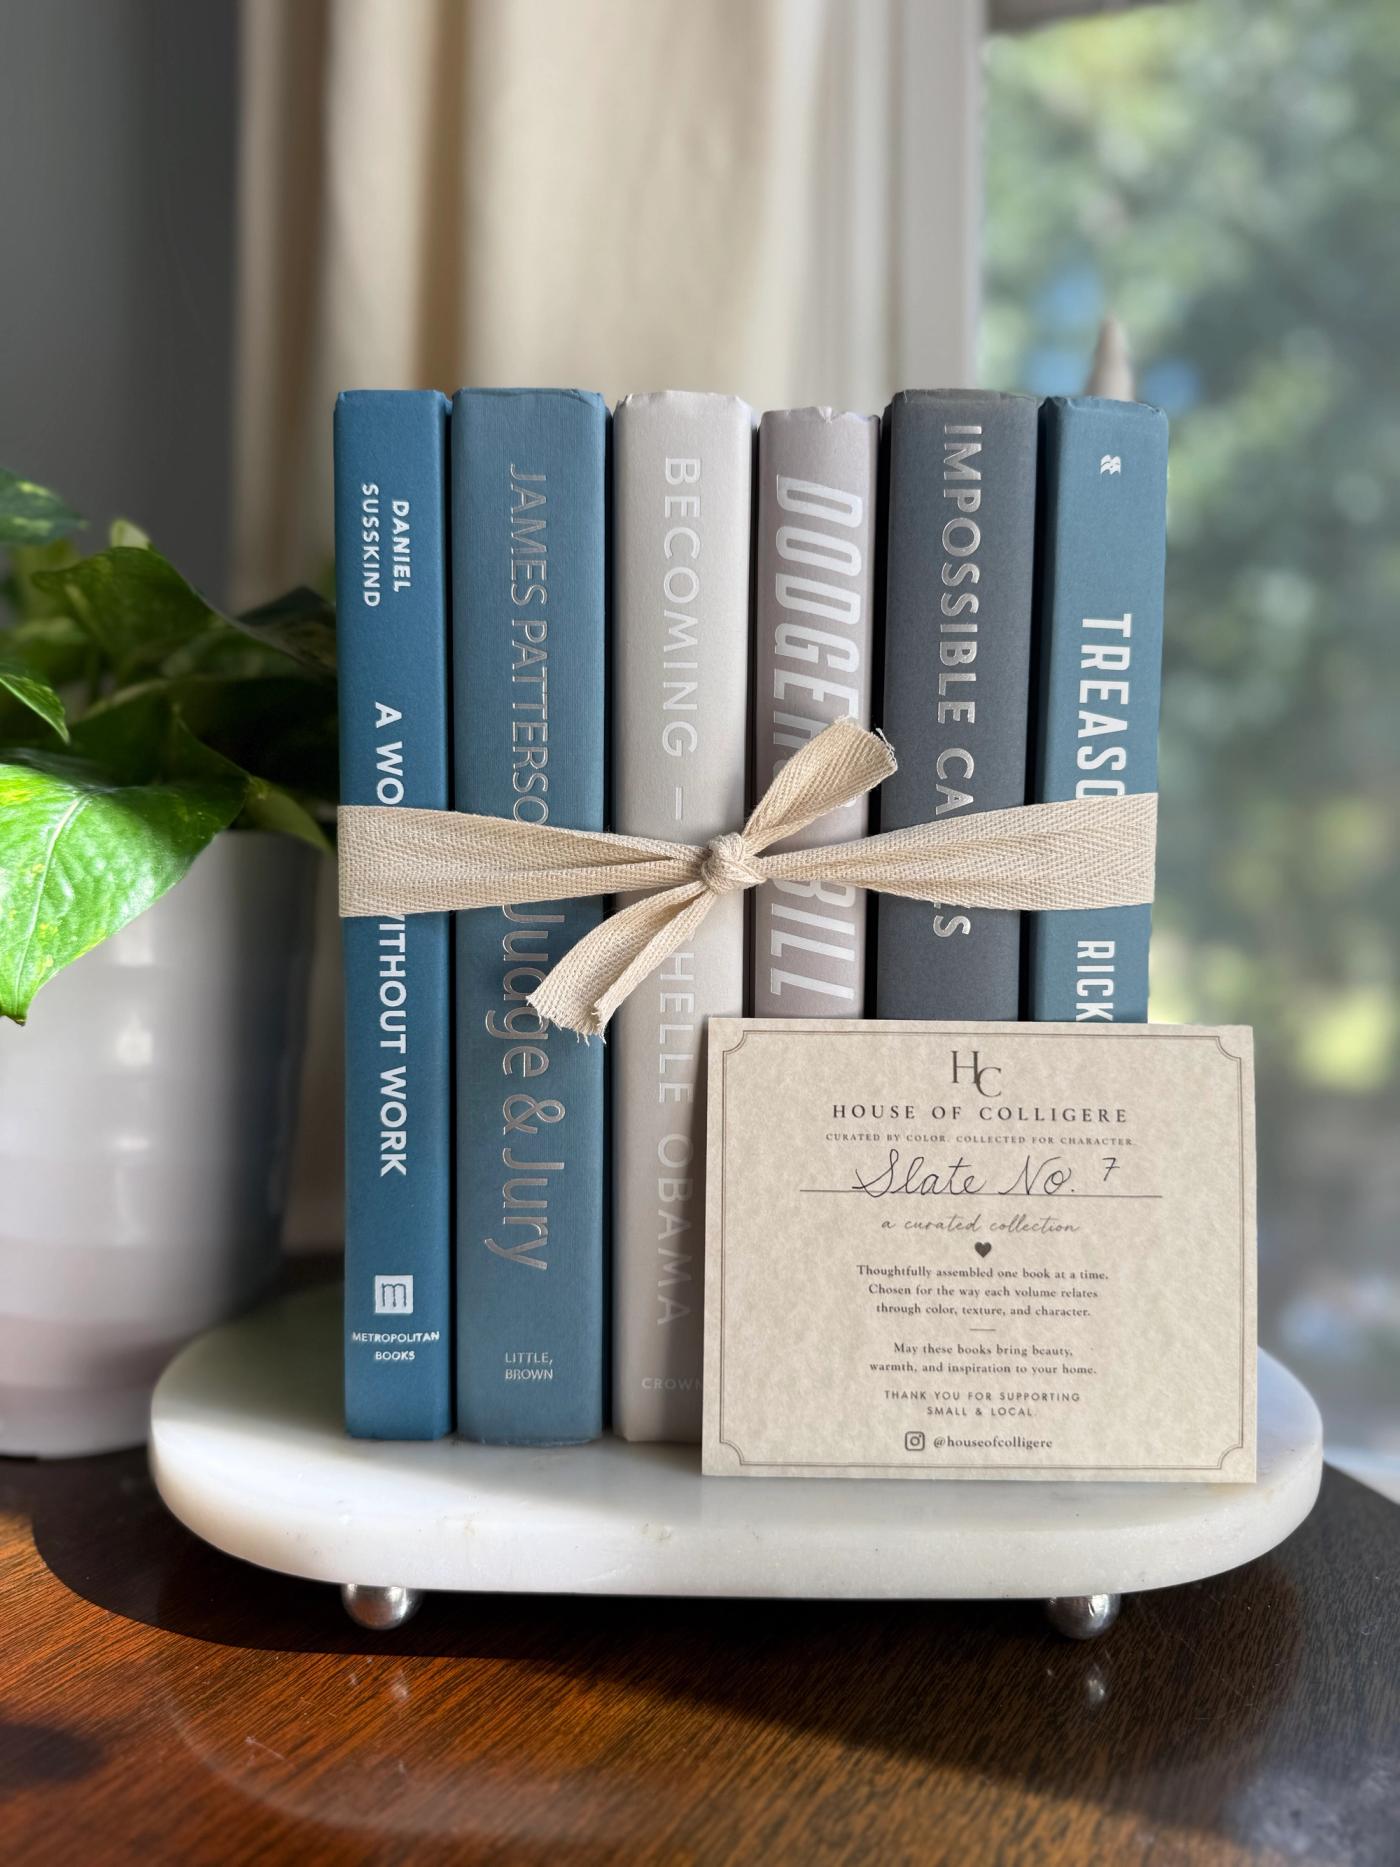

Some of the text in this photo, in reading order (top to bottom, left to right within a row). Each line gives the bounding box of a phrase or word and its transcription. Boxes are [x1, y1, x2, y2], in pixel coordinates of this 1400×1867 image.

[360, 483, 382, 608] SUSSKIND
[391, 500, 412, 593] DANIEL
[937, 424, 983, 725] IMPOSSIBLE
[661, 456, 701, 758] BECOMING
[510, 463, 550, 826] JAMES PATTERSO
[374, 701, 403, 729] A
[1075, 612, 1133, 799] TREASO
[378, 912, 408, 1054] ITHOUT
[1075, 940, 1116, 1022] RICK
[950, 1050, 1003, 1098] HC
[484, 904, 566, 1271] Judge & Jury
[379, 1065, 408, 1178] WORK
[832, 1104, 1129, 1123] HOUSE OF COLLIGERE
[825, 1132, 882, 1143] CURATED
[886, 1133, 900, 1143] BY
[905, 1134, 950, 1144] COLOR.
[955, 1135, 1027, 1145] COLLECTED
[1031, 1135, 1055, 1145] FOR
[851, 1148, 1121, 1198] Slate No. 7
[656, 1134, 695, 1326] OBAMA
[881, 1213, 1081, 1234] a curated collection
[856, 1264, 1109, 1281] Thoughtfully assembled one book at a time.
[868, 1283, 1099, 1299] Chosen for the way each volume relates
[876, 1303, 1091, 1318] through color, texture, and character.
[351, 1331, 440, 1344] METROPOLITAN
[374, 1350, 416, 1362] BOOKS
[505, 1351, 553, 1366] LITTLE,
[893, 1342, 1073, 1359] May these books bring beauty,
[505, 1368, 554, 1381] BROWN
[869, 1361, 1098, 1378] warmth, and inspiration to your home.
[884, 1390, 1081, 1402] THANK YOU FOR SUPPORTING
[927, 1406, 968, 1416] SMALL
[975, 1407, 983, 1416] &
[933, 1435, 1053, 1450] @houseofcolligere
